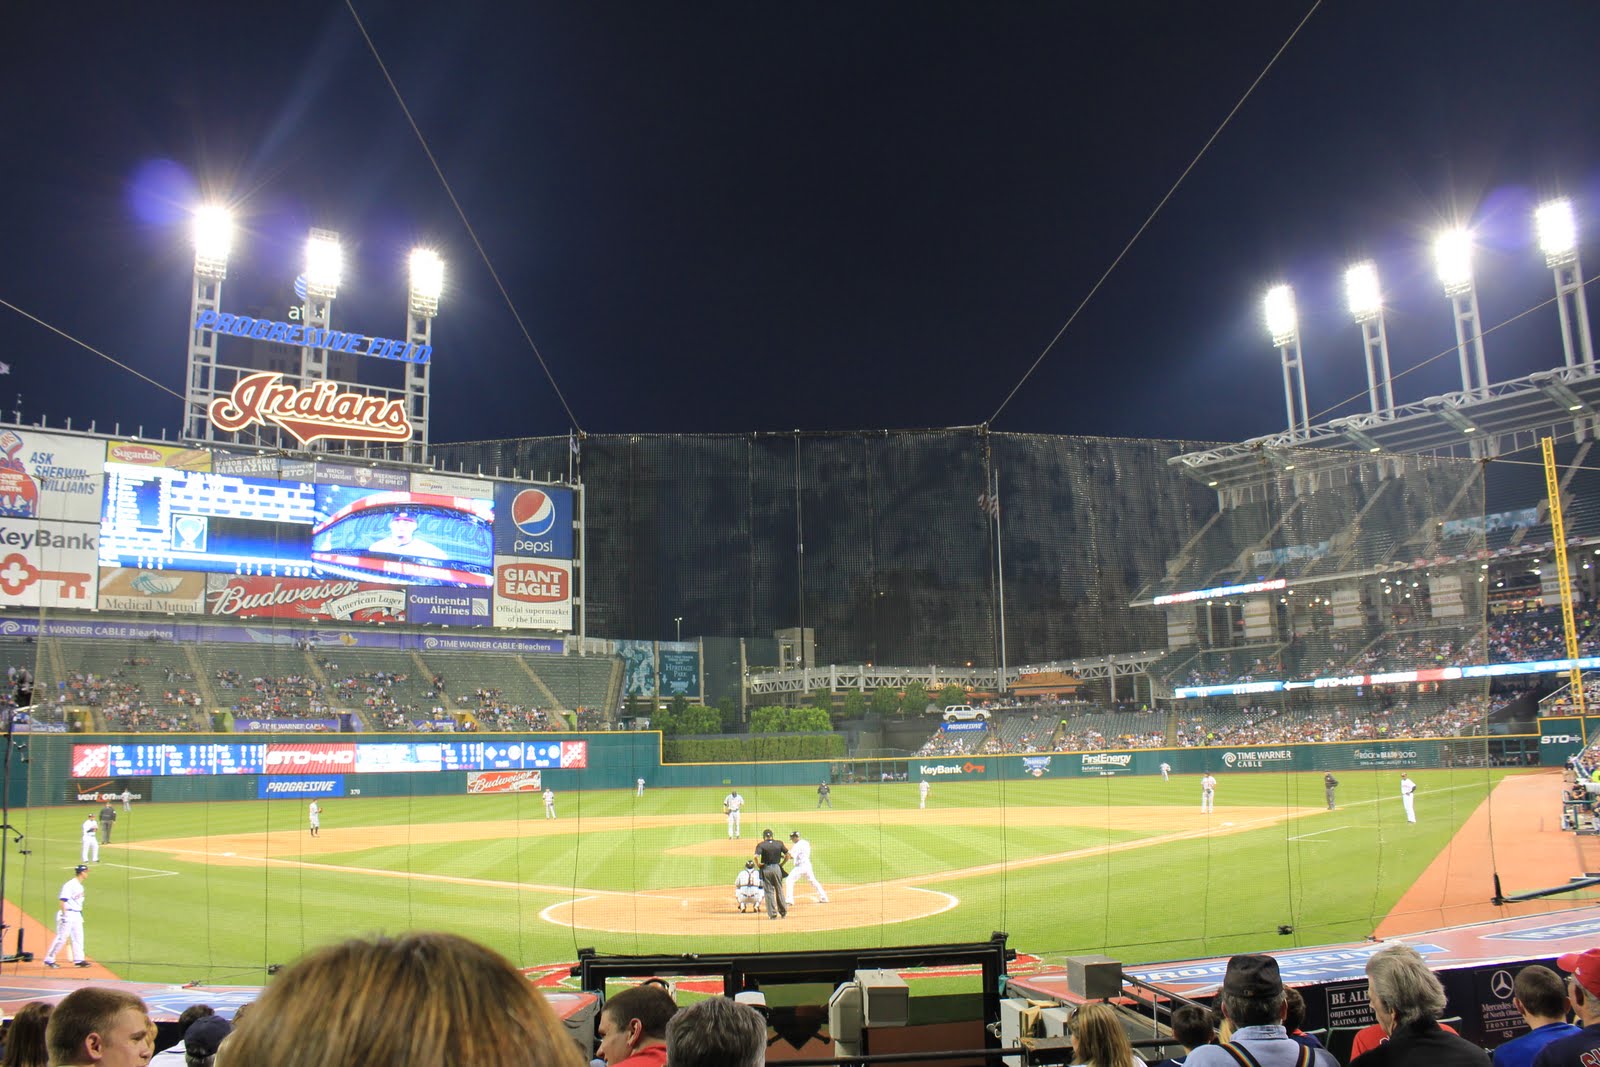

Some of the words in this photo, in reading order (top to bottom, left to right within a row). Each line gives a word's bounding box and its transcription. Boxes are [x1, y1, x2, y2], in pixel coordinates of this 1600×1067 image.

[195, 310, 364, 353] PROGRESSIVE
[367, 338, 432, 364] FIELD
[208, 371, 412, 444] Indians
[29, 452, 54, 465] ASK
[113, 447, 160, 460] Sugardale
[216, 463, 278, 473] MAGAZINE
[40, 480, 95, 495] WILLIAMS
[513, 540, 553, 554] pepsi
[504, 568, 562, 584] GIANT
[505, 583, 561, 597] EAGLE
[207, 581, 359, 615] Budweiser
[337, 595, 378, 612] American
[380, 595, 403, 605] Lager
[410, 595, 470, 606] Continental
[106, 598, 153, 611] Medical
[157, 599, 197, 612] Mutual
[430, 605, 470, 616] Airlines
[496, 605, 523, 614] Official
[525, 607, 569, 617] supermarket
[516, 616, 528, 624] the
[22, 624, 47, 634] TIME
[49, 625, 92, 635] WARNER
[95, 627, 126, 636] CABLE
[129, 628, 173, 638] Bleachers
[440, 639, 458, 648] TIME
[460, 640, 491, 649] WARNER
[1541, 735, 1570, 744] STO
[1081, 753, 1131, 765] FirstEnergy
[1237, 751, 1256, 760] TIME
[1257, 750, 1292, 760] WARNER
[920, 764, 963, 776] KeyBank
[266, 781, 336, 793] PROGRESSIVE
[468, 770, 533, 792] Budweiser
[77, 791, 116, 802] verizon
[1332, 992, 1346, 1004] BE
[1349, 990, 1370, 1002] ALE
[1330, 1008, 1355, 1018] OBJECTS
[1356, 1007, 1369, 1015] MAY
[1332, 1018, 1357, 1026] SEATING
[1486, 1020, 1509, 1029] FRONT
